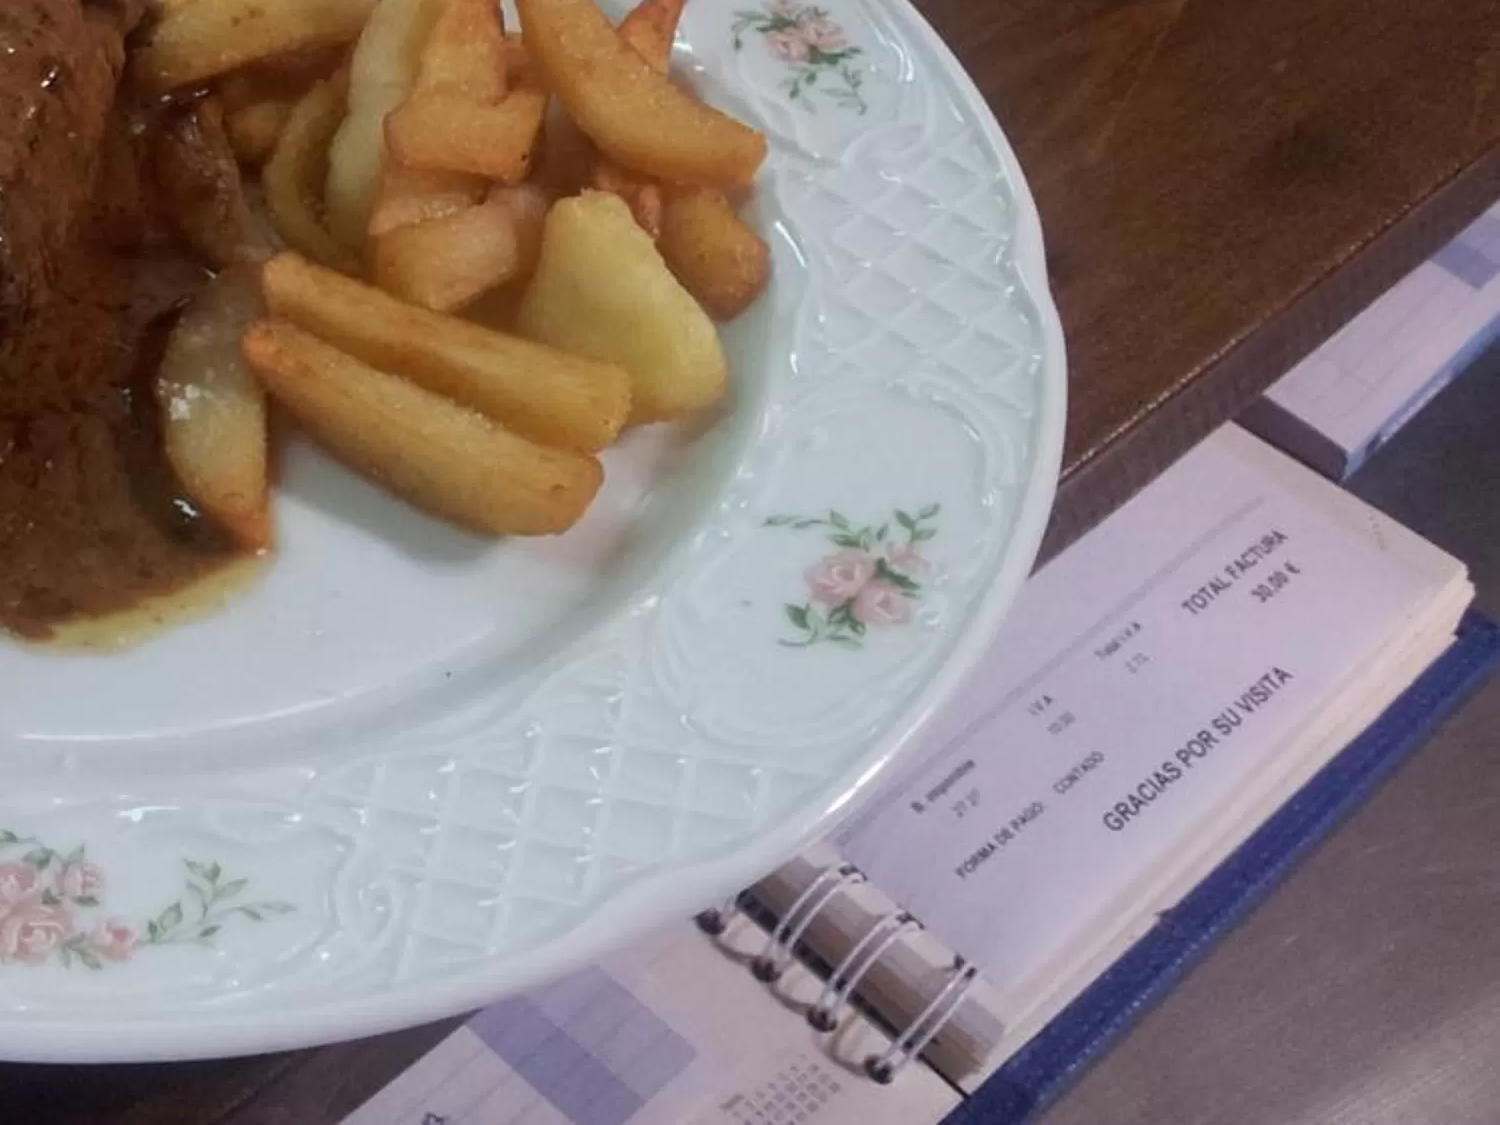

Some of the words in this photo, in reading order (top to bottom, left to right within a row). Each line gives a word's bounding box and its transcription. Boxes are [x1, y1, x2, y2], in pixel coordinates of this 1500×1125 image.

[1180, 577, 1232, 615] TOTAL
[1224, 529, 1289, 579] FACTURA
[1052, 750, 1105, 794] CONTADO
[1102, 761, 1183, 832] GRACIAS
[1175, 730, 1220, 768] POR
[1211, 706, 1243, 736] SU
[1233, 666, 1295, 713] VISITA
[955, 842, 997, 878] FORMA
[994, 826, 1015, 845] DE
